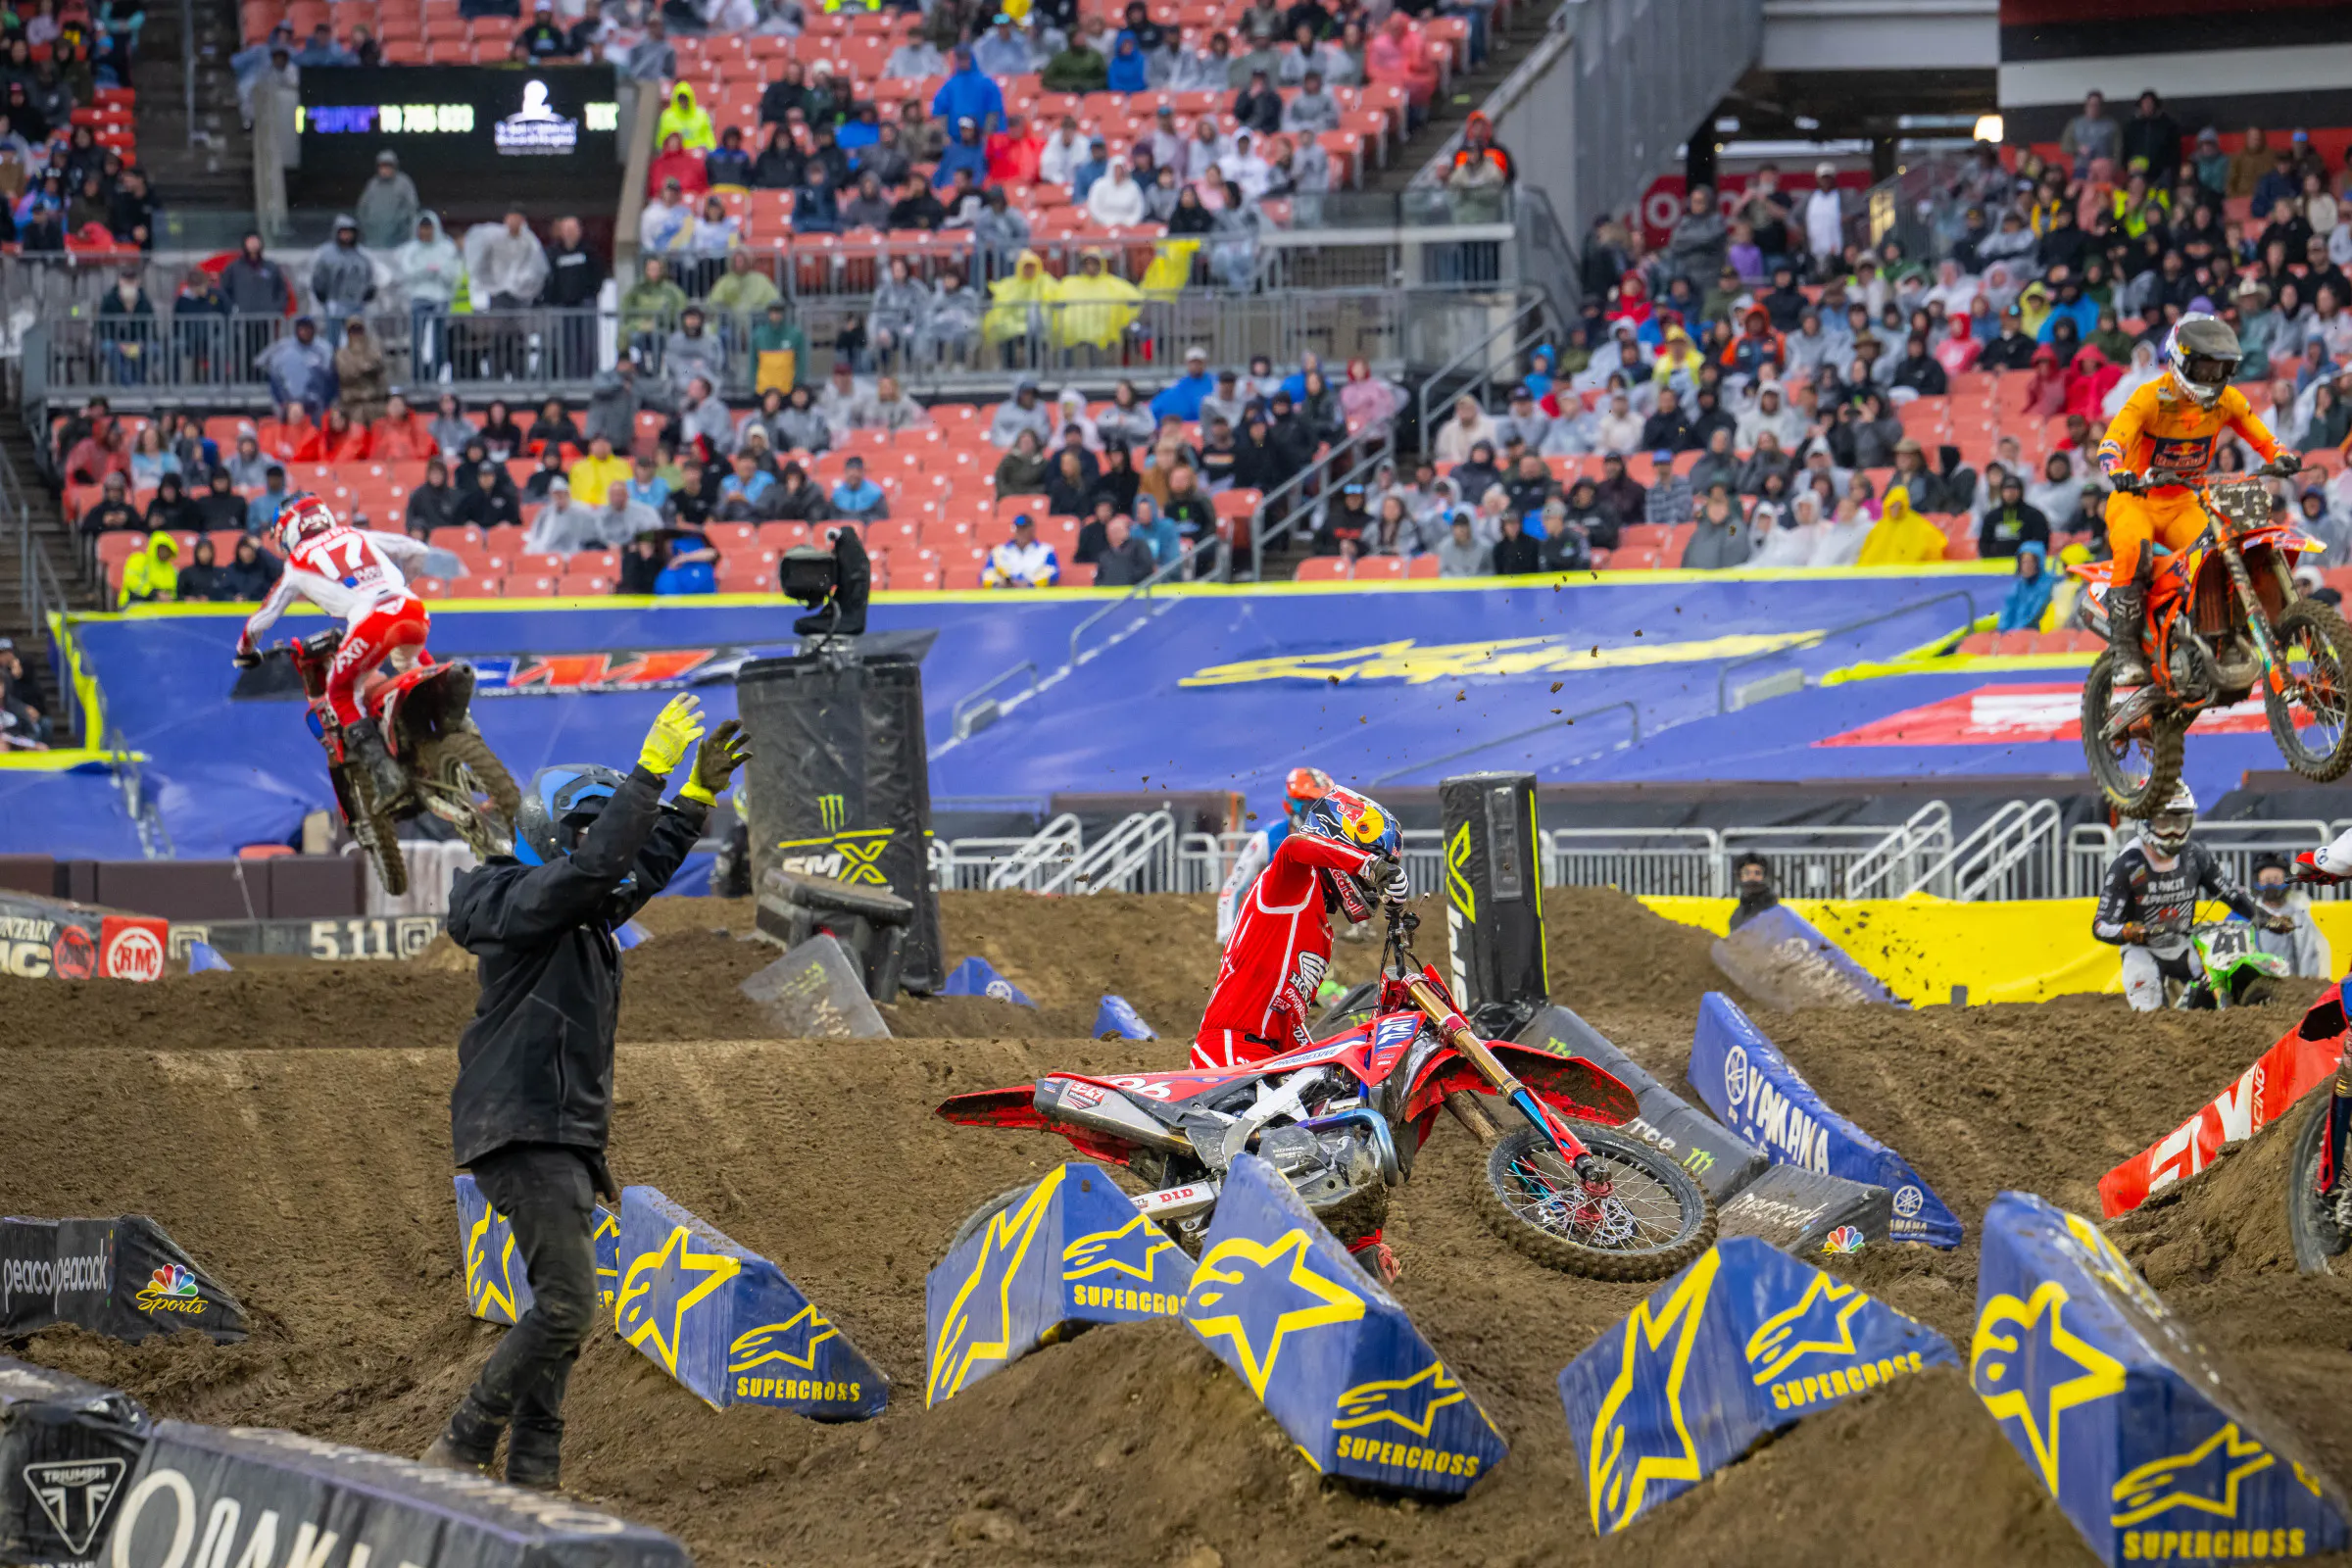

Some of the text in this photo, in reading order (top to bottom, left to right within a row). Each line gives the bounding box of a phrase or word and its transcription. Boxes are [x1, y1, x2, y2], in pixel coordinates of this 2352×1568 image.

[307, 532, 364, 580] 17
[2212, 931, 2247, 956] 41
[1747, 1065, 1831, 1175] YAMAHA
[3, 1238, 108, 1315] peaco peacock
[135, 1288, 209, 1316] Sports
[1074, 1284, 1187, 1315] SUPERCRO
[736, 1376, 860, 1402] SUPERCROSS
[1771, 1351, 1923, 1410] SUPERCROSS
[1337, 1434, 1480, 1478] SUPERCROSS
[42, 1466, 107, 1484] TRIUMPH
[2123, 1528, 2306, 1560] SUPERCROSS
